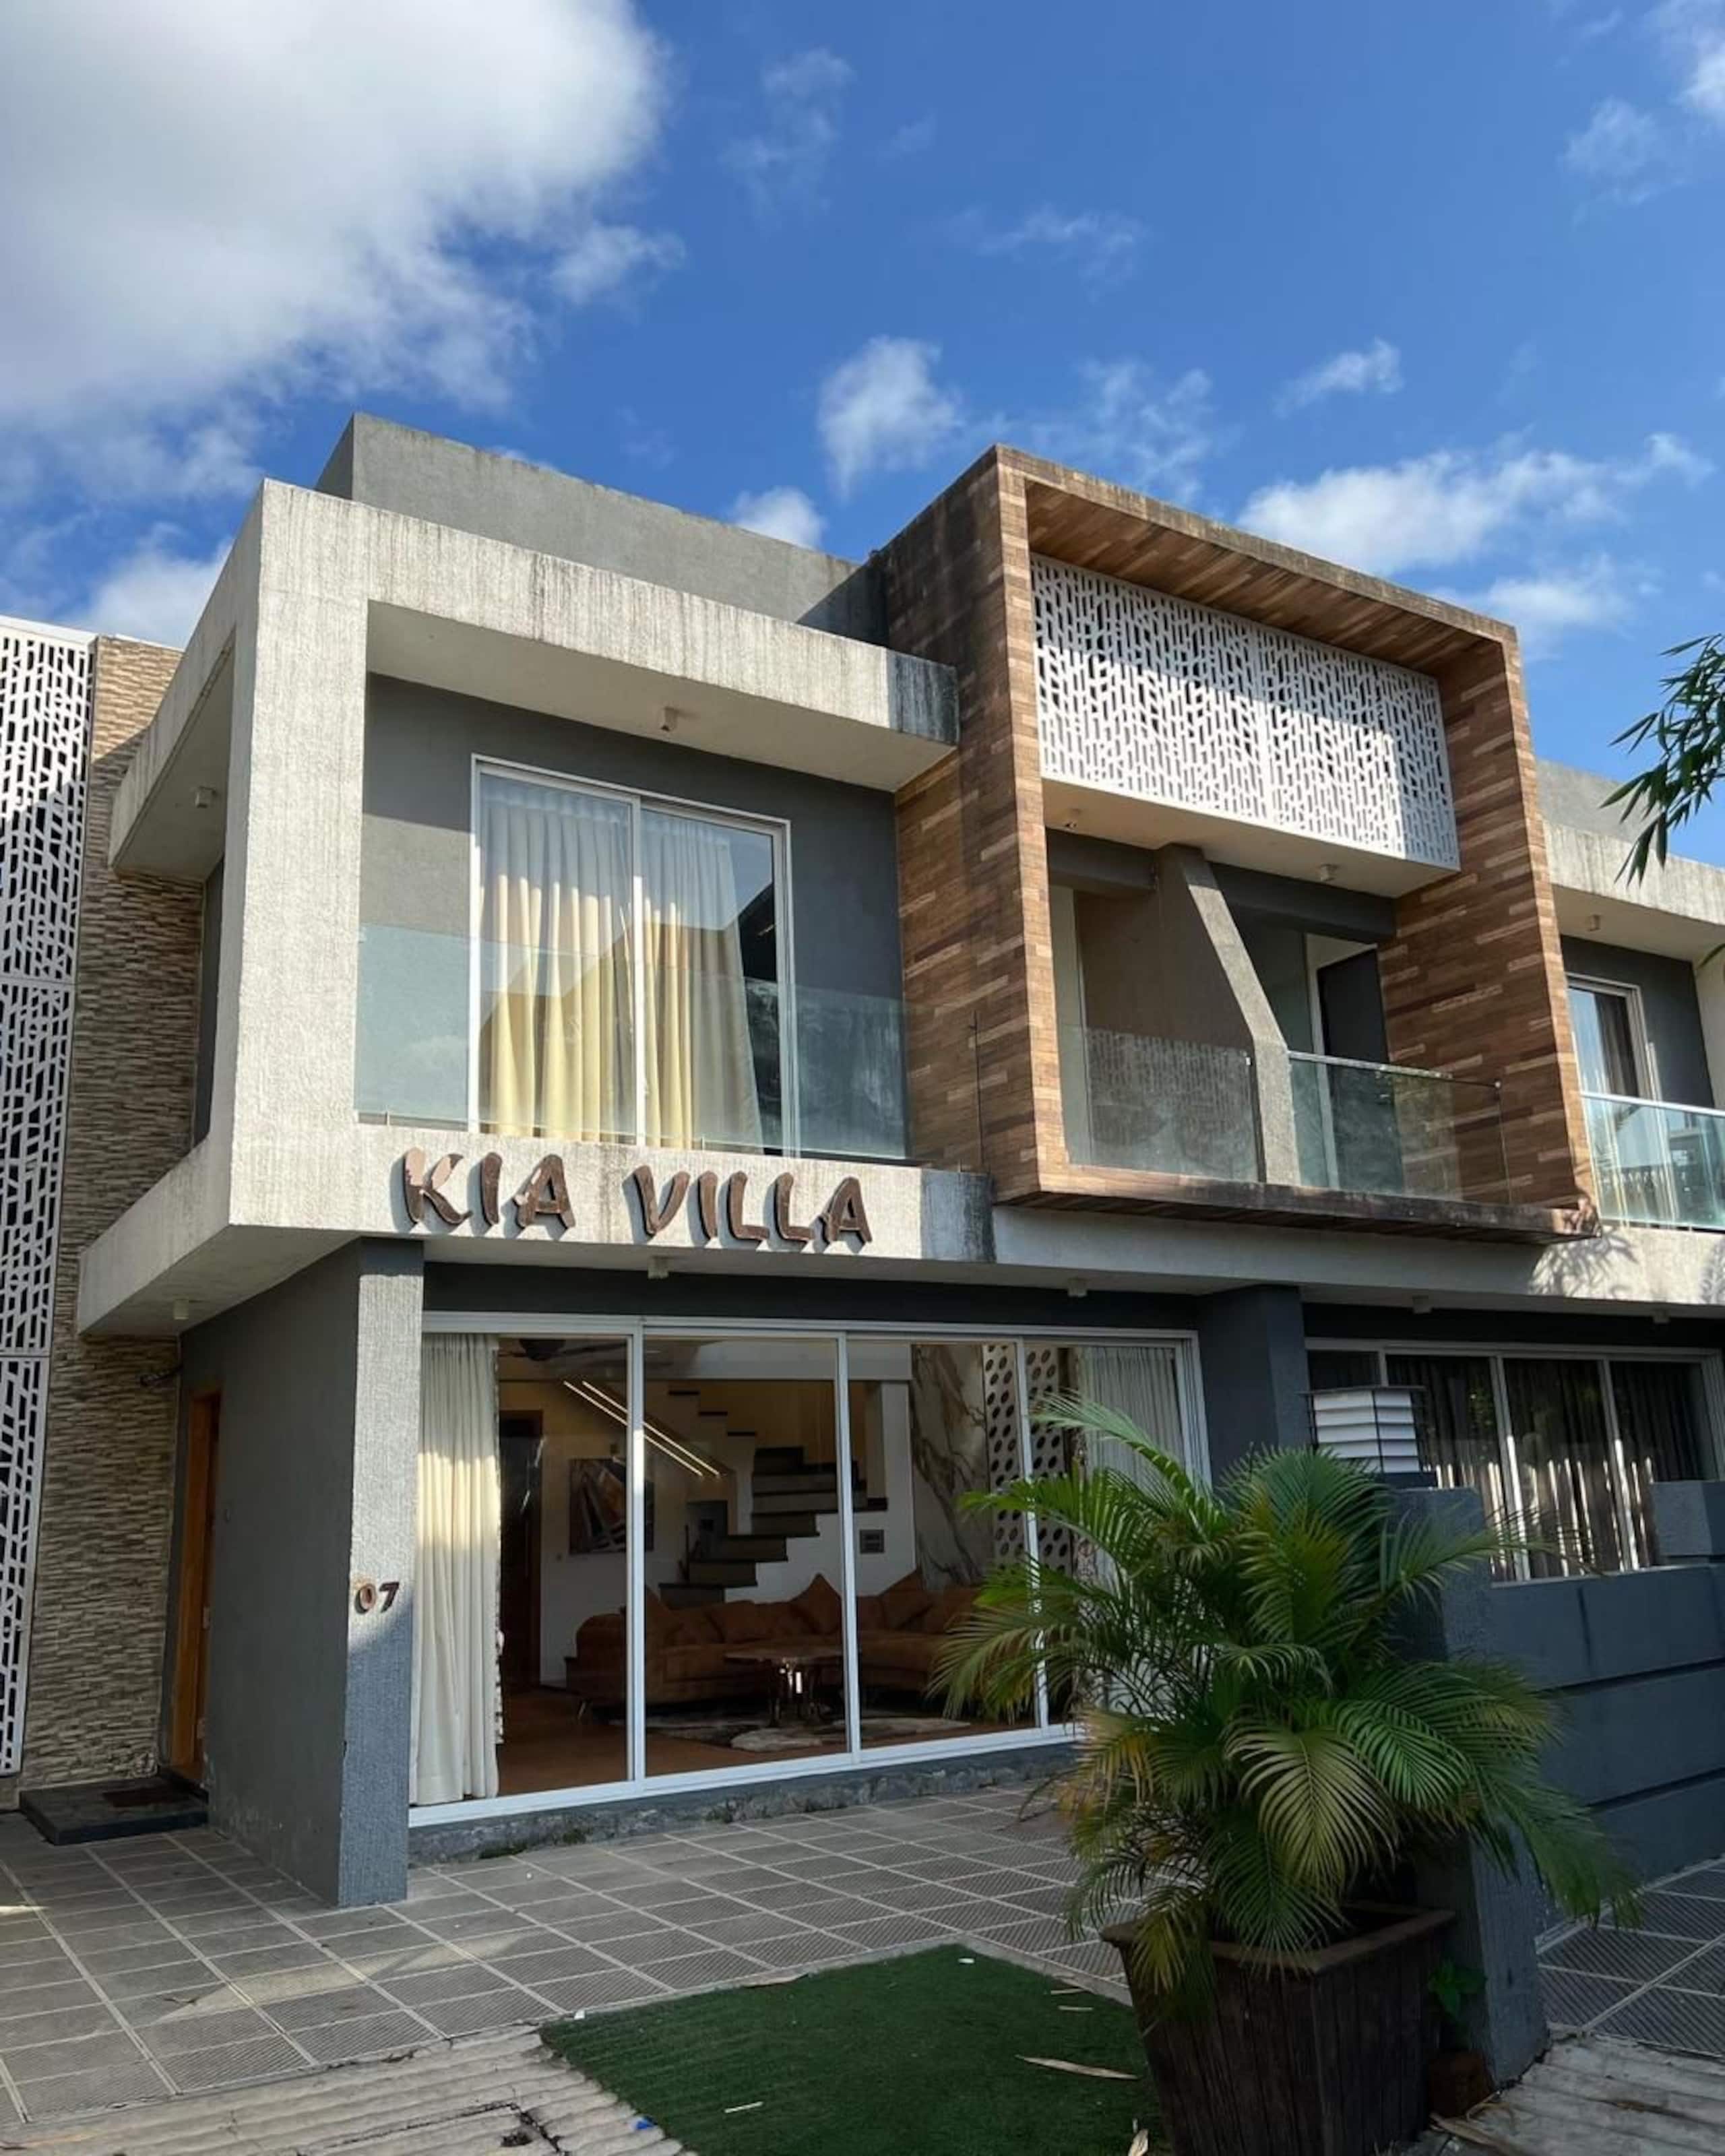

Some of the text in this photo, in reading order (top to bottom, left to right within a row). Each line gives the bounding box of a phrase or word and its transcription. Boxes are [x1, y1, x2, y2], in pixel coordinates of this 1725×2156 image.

[404, 1147, 873, 1244] KIA VILLA
[354, 1581, 400, 1614] 07
